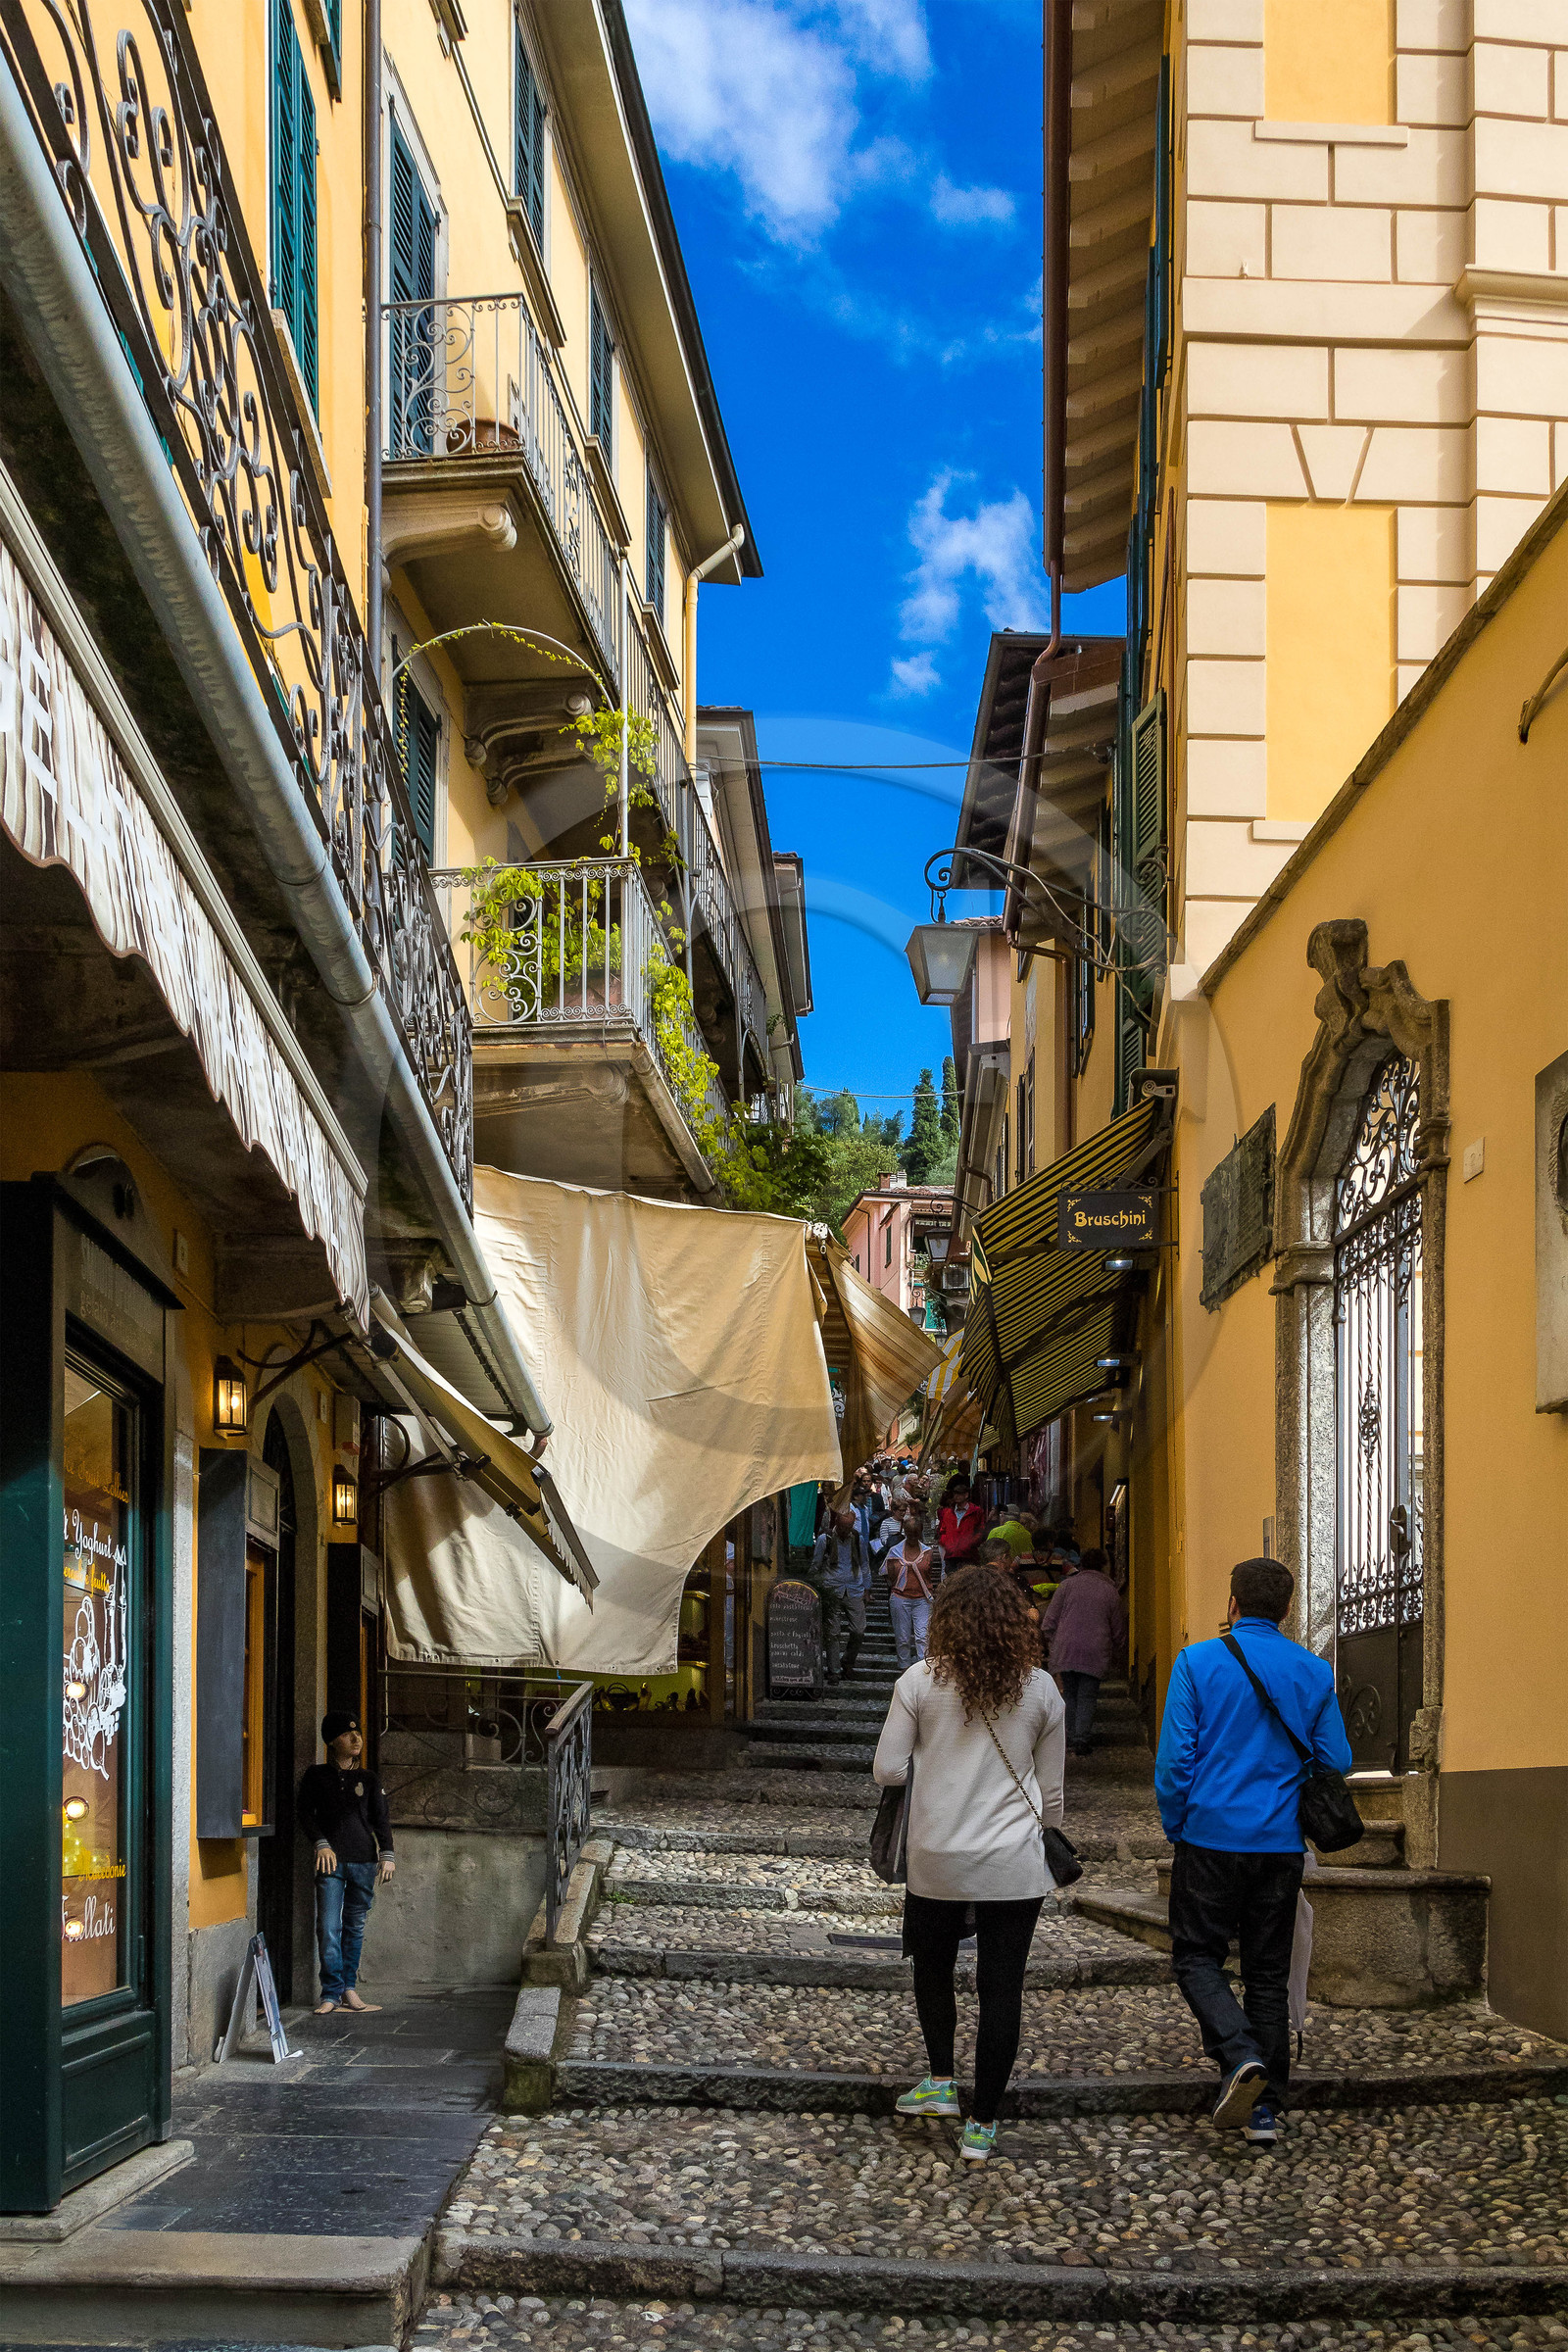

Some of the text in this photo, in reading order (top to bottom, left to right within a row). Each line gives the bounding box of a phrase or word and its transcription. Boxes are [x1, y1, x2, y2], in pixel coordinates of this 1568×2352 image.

[1074, 1209, 1147, 1229] Bruschini
[73, 1508, 114, 1566] Yoghurt
[62, 1894, 116, 1943] Fllati
